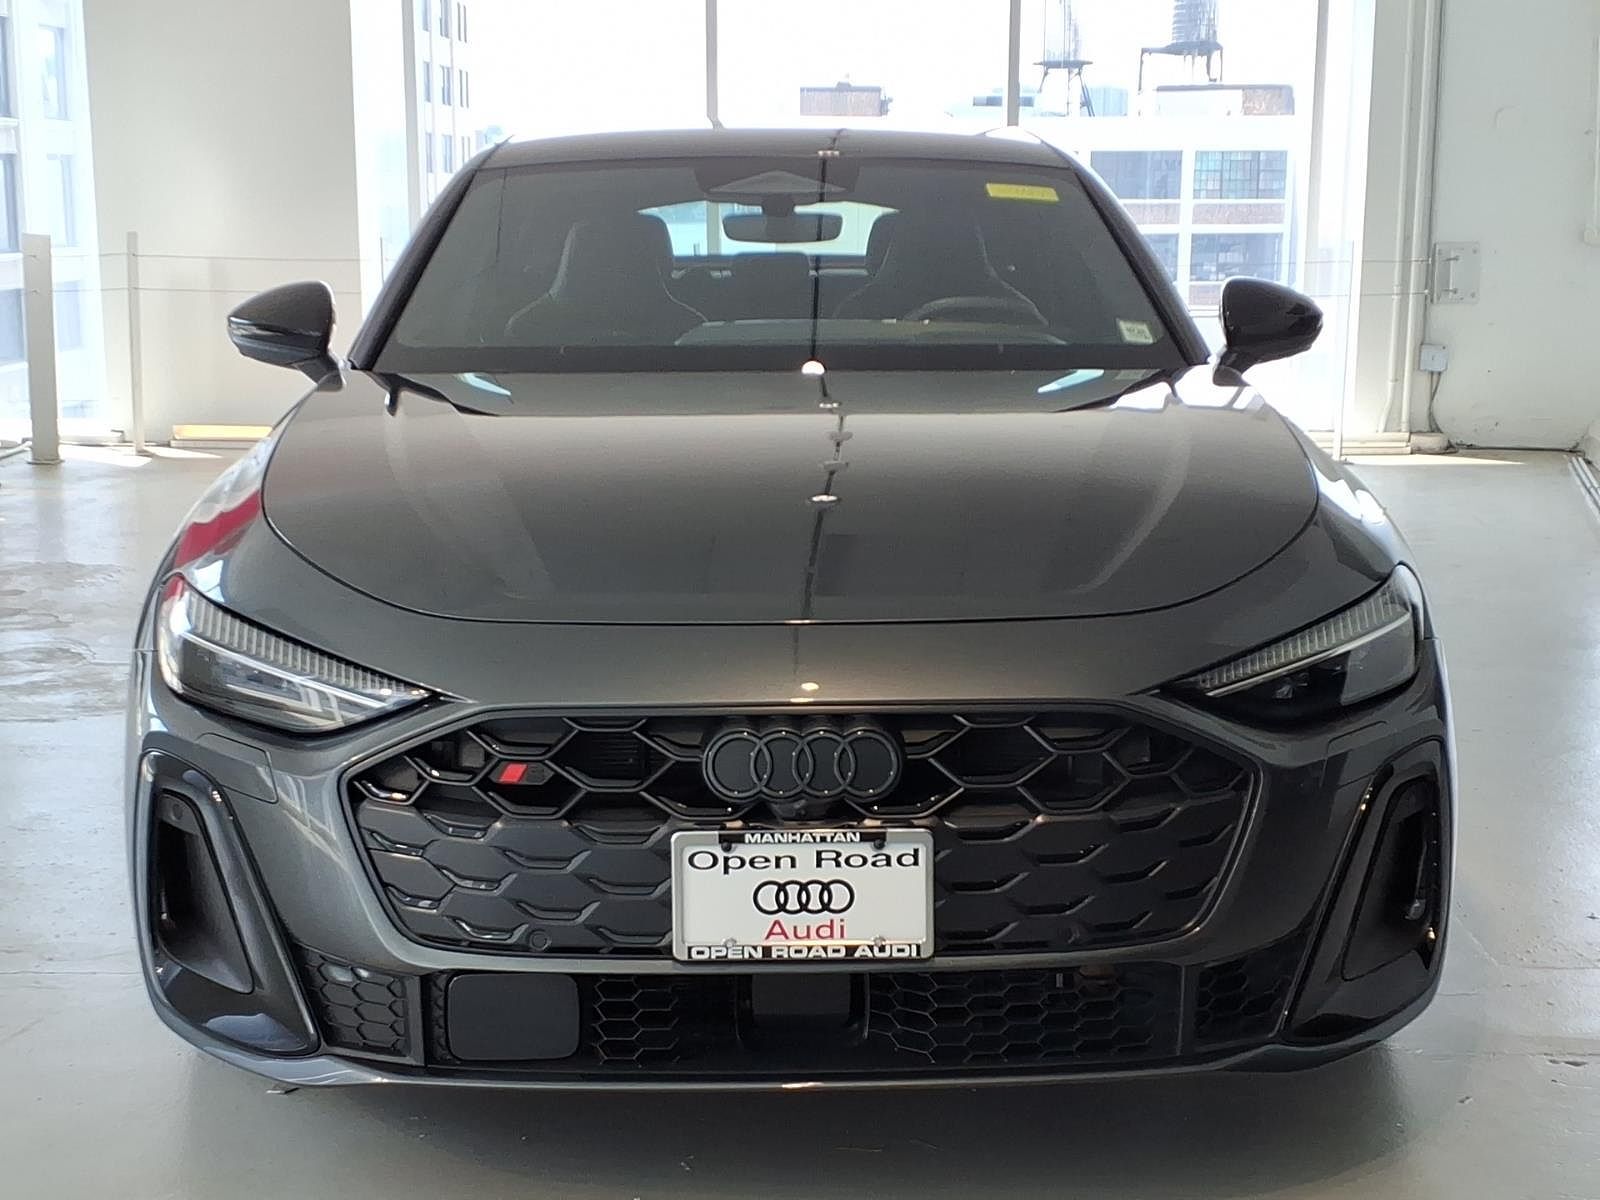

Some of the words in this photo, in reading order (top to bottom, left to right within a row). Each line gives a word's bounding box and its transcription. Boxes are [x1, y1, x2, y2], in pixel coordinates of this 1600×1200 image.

[744, 832, 861, 844] MANHATTAN
[687, 850, 797, 875] Open
[815, 848, 919, 868] Road
[764, 918, 846, 940] Audi
[690, 946, 763, 959] OPEN
[771, 945, 846, 958] ROAD
[854, 944, 917, 957] AUDI
